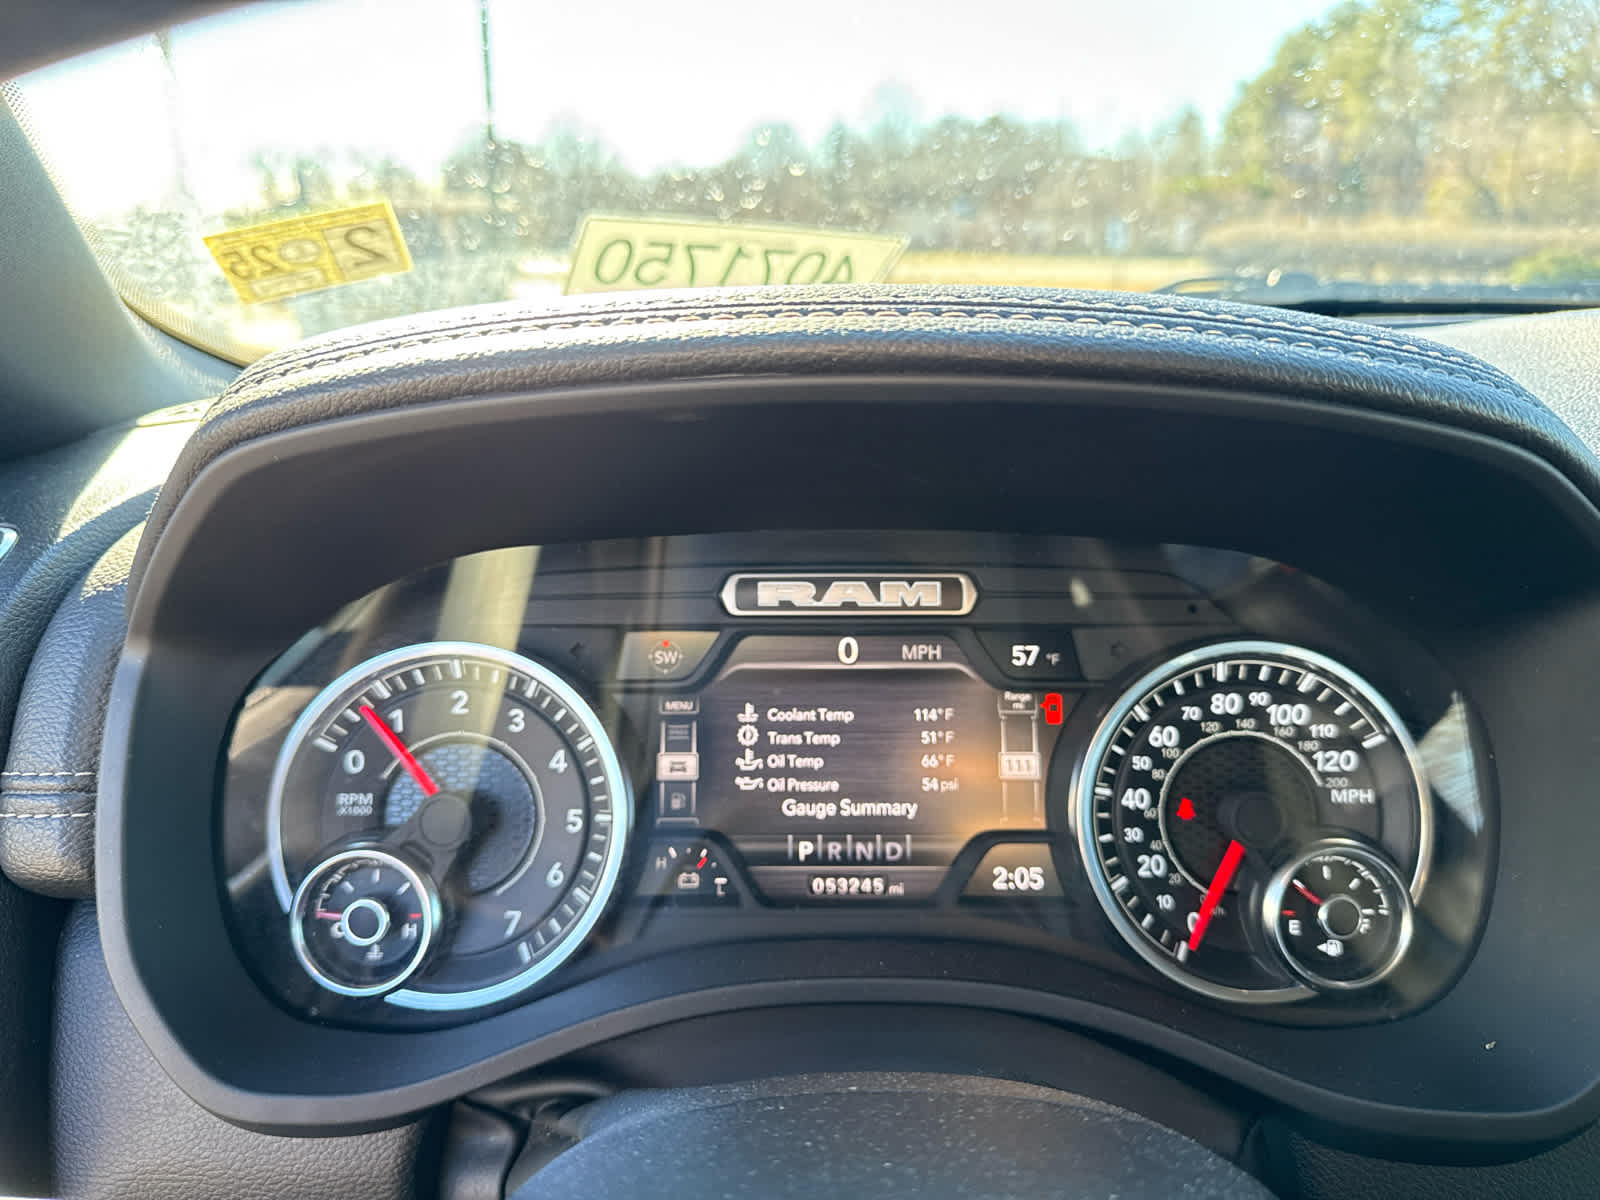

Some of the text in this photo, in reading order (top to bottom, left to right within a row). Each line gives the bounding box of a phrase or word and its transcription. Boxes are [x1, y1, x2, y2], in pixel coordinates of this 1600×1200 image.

[757, 581, 942, 607] RAM
[654, 651, 678, 664] SW
[838, 636, 942, 664] 0 MPH
[1011, 645, 1040, 666] 57
[450, 690, 470, 715] 2
[1004, 690, 1033, 704] Range
[1210, 693, 1243, 715] 80
[1248, 692, 1272, 706] 90
[387, 709, 403, 732] 1
[508, 708, 526, 733] 3
[767, 707, 817, 722] Coolant
[817, 707, 855, 723] Temp
[1181, 706, 1202, 721] 70
[1266, 704, 1311, 726] 100
[1200, 721, 1221, 733] 120
[1235, 718, 1256, 729] 140
[1309, 724, 1338, 738] 110
[767, 730, 803, 745] Trans
[803, 731, 841, 747] Temp
[1149, 725, 1180, 748] 60
[343, 750, 366, 773] 0
[548, 750, 568, 774] 4
[1161, 748, 1181, 759] 100
[1312, 750, 1359, 772] 120
[767, 754, 786, 769] Oil
[787, 754, 824, 771] Temp
[1132, 756, 1152, 771] 50
[767, 777, 959, 793] Oil Pressure 54 psi
[1325, 777, 1348, 788] 200
[337, 793, 374, 805] RPM
[1121, 788, 1150, 810] 40
[1330, 789, 1375, 803] MPH
[781, 798, 918, 820] Gauge Summary
[565, 809, 583, 834] 5
[1123, 827, 1144, 843] 30
[798, 841, 903, 862] P R N D
[1137, 854, 1167, 878] 20
[546, 862, 564, 888] 6
[992, 866, 1045, 891] 2:05
[1168, 873, 1182, 885] 20
[811, 877, 905, 895] 053245 mi
[1156, 895, 1175, 911] 10
[402, 923, 417, 939] H
[504, 910, 522, 937] 7
[1288, 920, 1302, 936] E
